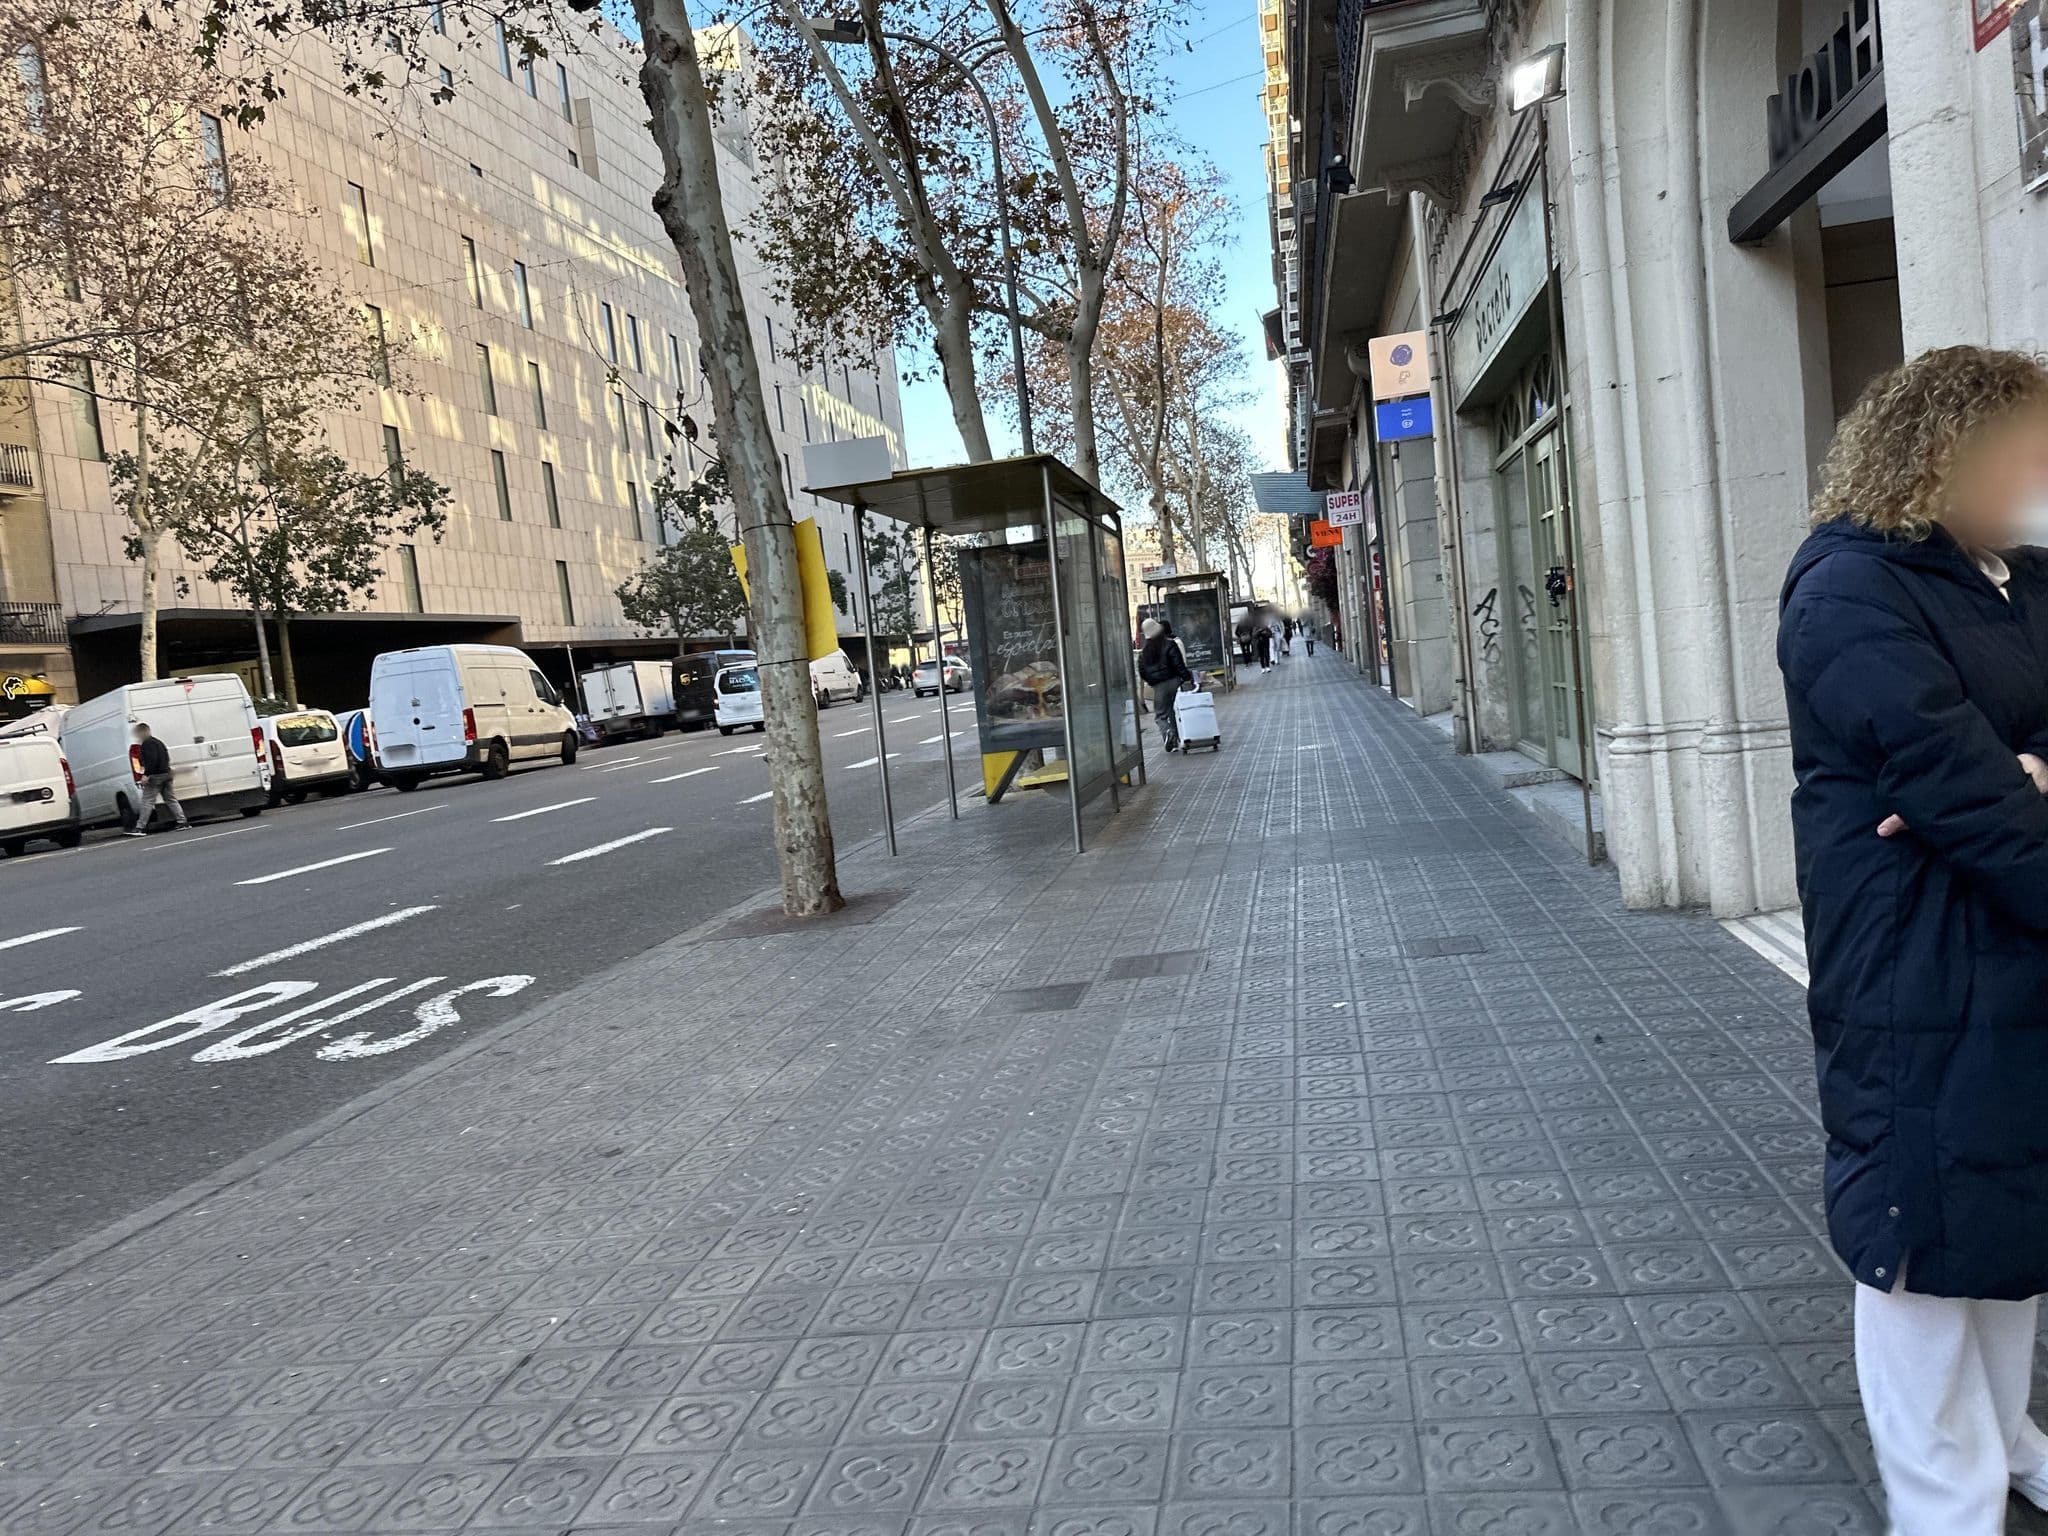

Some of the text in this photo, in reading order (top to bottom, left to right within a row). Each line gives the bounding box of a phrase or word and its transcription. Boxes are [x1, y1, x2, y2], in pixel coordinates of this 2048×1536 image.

[1475, 264, 1512, 353] Secreto
[1328, 494, 1360, 509] SUPER
[1335, 512, 1357, 522] 24H
[46, 974, 537, 1064] BUS
